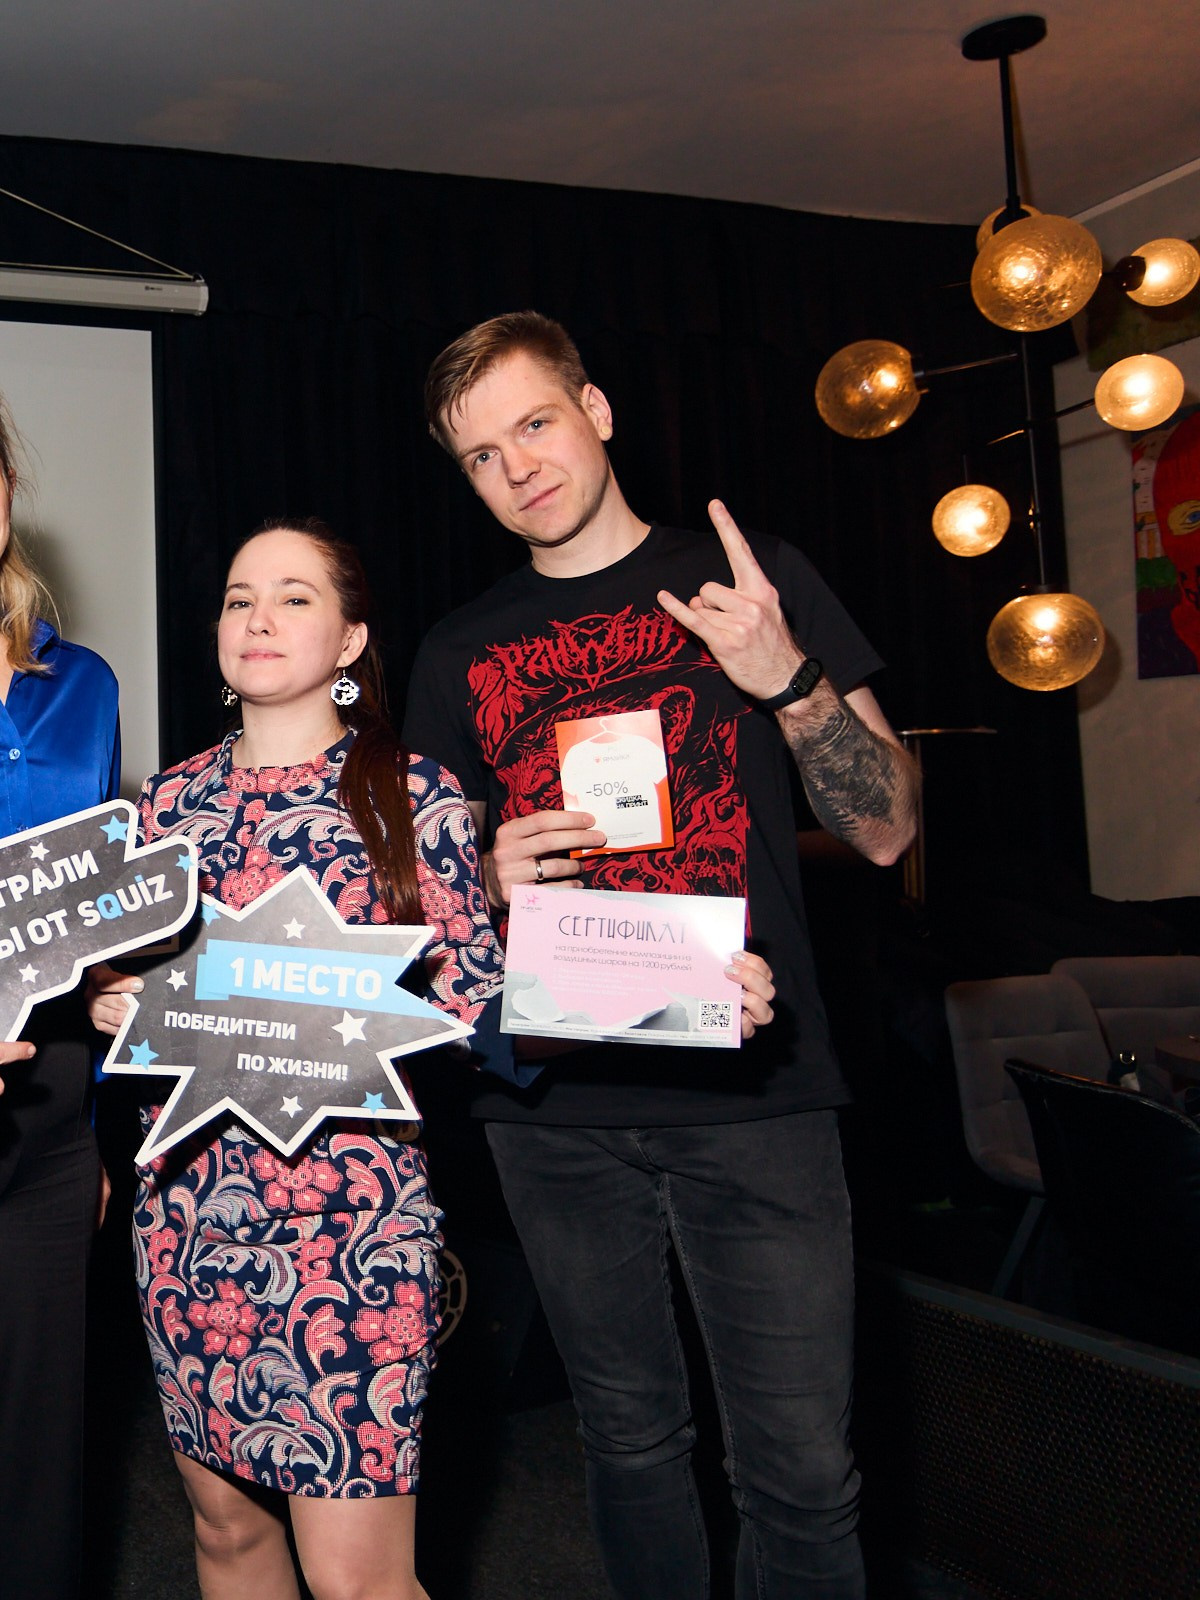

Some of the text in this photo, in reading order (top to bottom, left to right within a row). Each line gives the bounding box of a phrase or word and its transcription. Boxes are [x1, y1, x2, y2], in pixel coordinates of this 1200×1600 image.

[586, 781, 628, 797] -50%
[26, 908, 70, 947] ОТ
[558, 915, 688, 944] СЕРТИФИКАТ
[553, 954, 598, 965] воздушных
[598, 958, 627, 968] шаров
[641, 961, 660, 969] 1200
[660, 962, 692, 972] рублей
[567, 946, 628, 957] приобретение
[230, 957, 382, 1000] 1 МЕСТО
[164, 1011, 296, 1040] ПОБЕДИТЕЛИ
[236, 1053, 348, 1081] ПО ЖИЗНИ!
